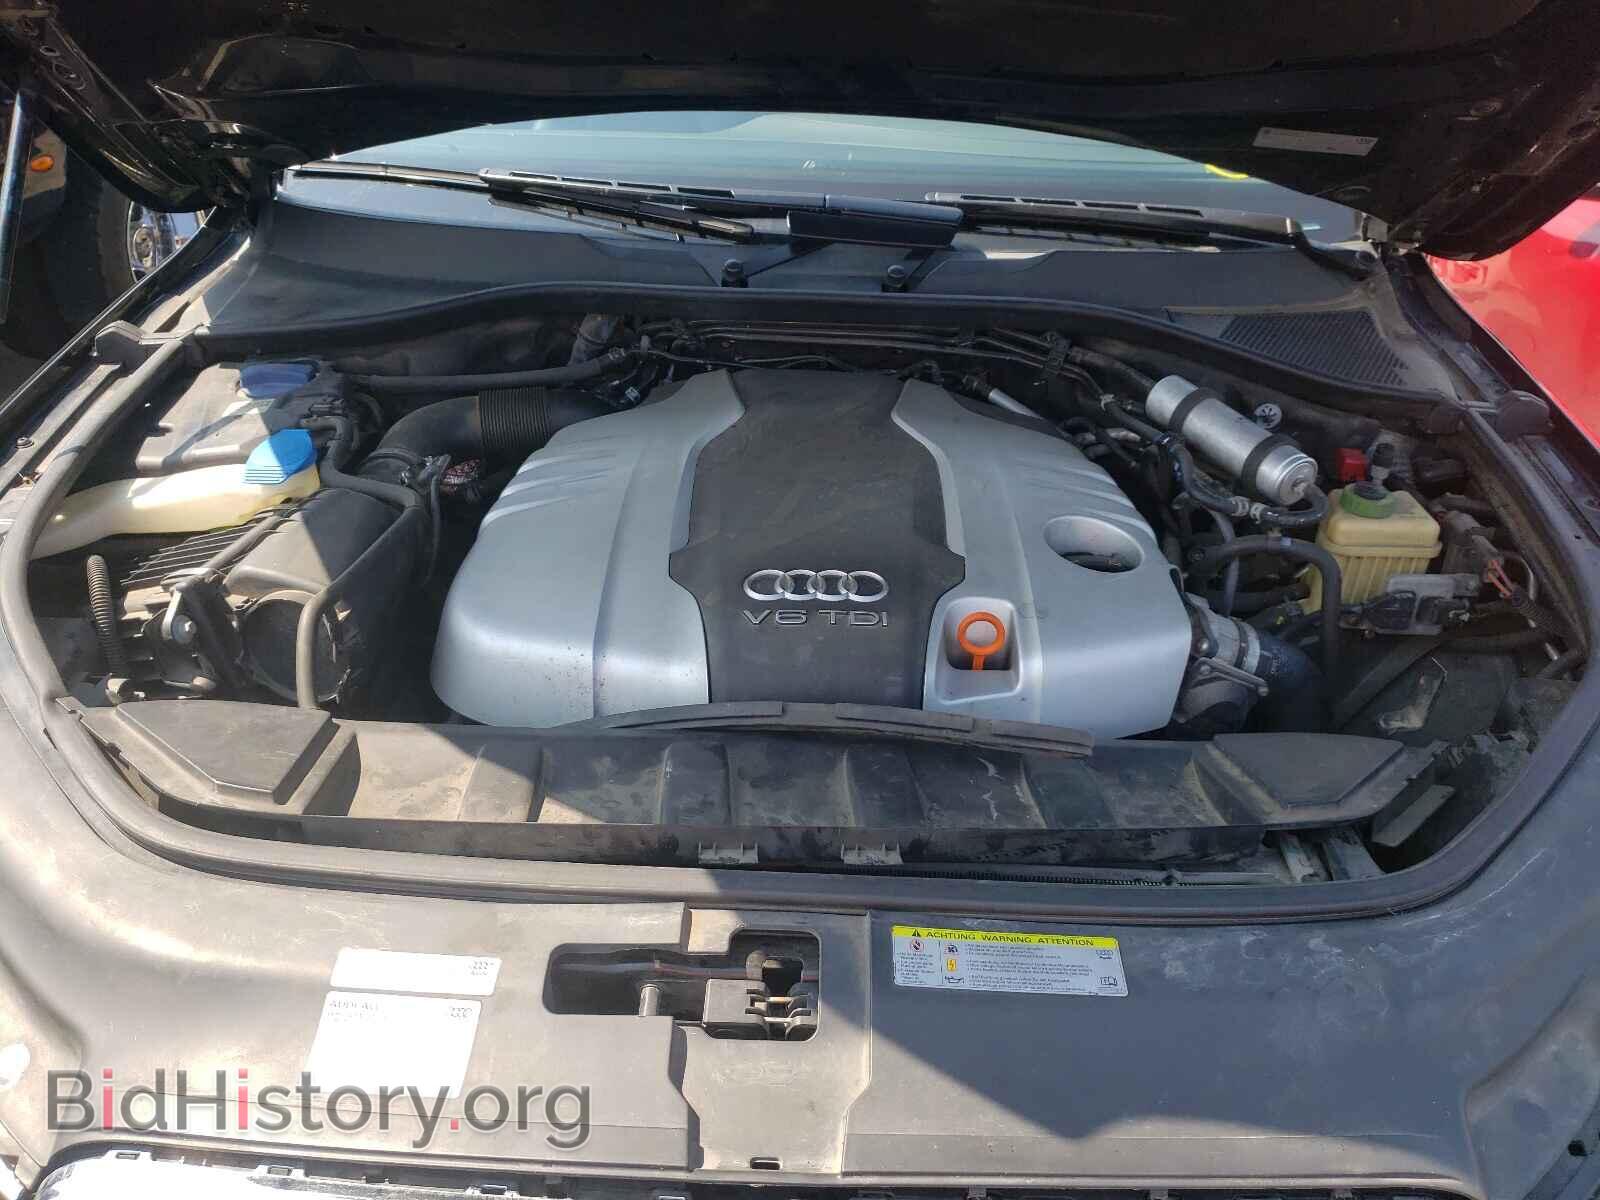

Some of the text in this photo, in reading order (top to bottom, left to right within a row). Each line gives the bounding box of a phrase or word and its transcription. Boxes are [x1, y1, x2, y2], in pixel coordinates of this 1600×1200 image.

[743, 609, 888, 626] V6 TDI
[926, 930, 1095, 947] ACHTUNG WARNING ATTENTION
